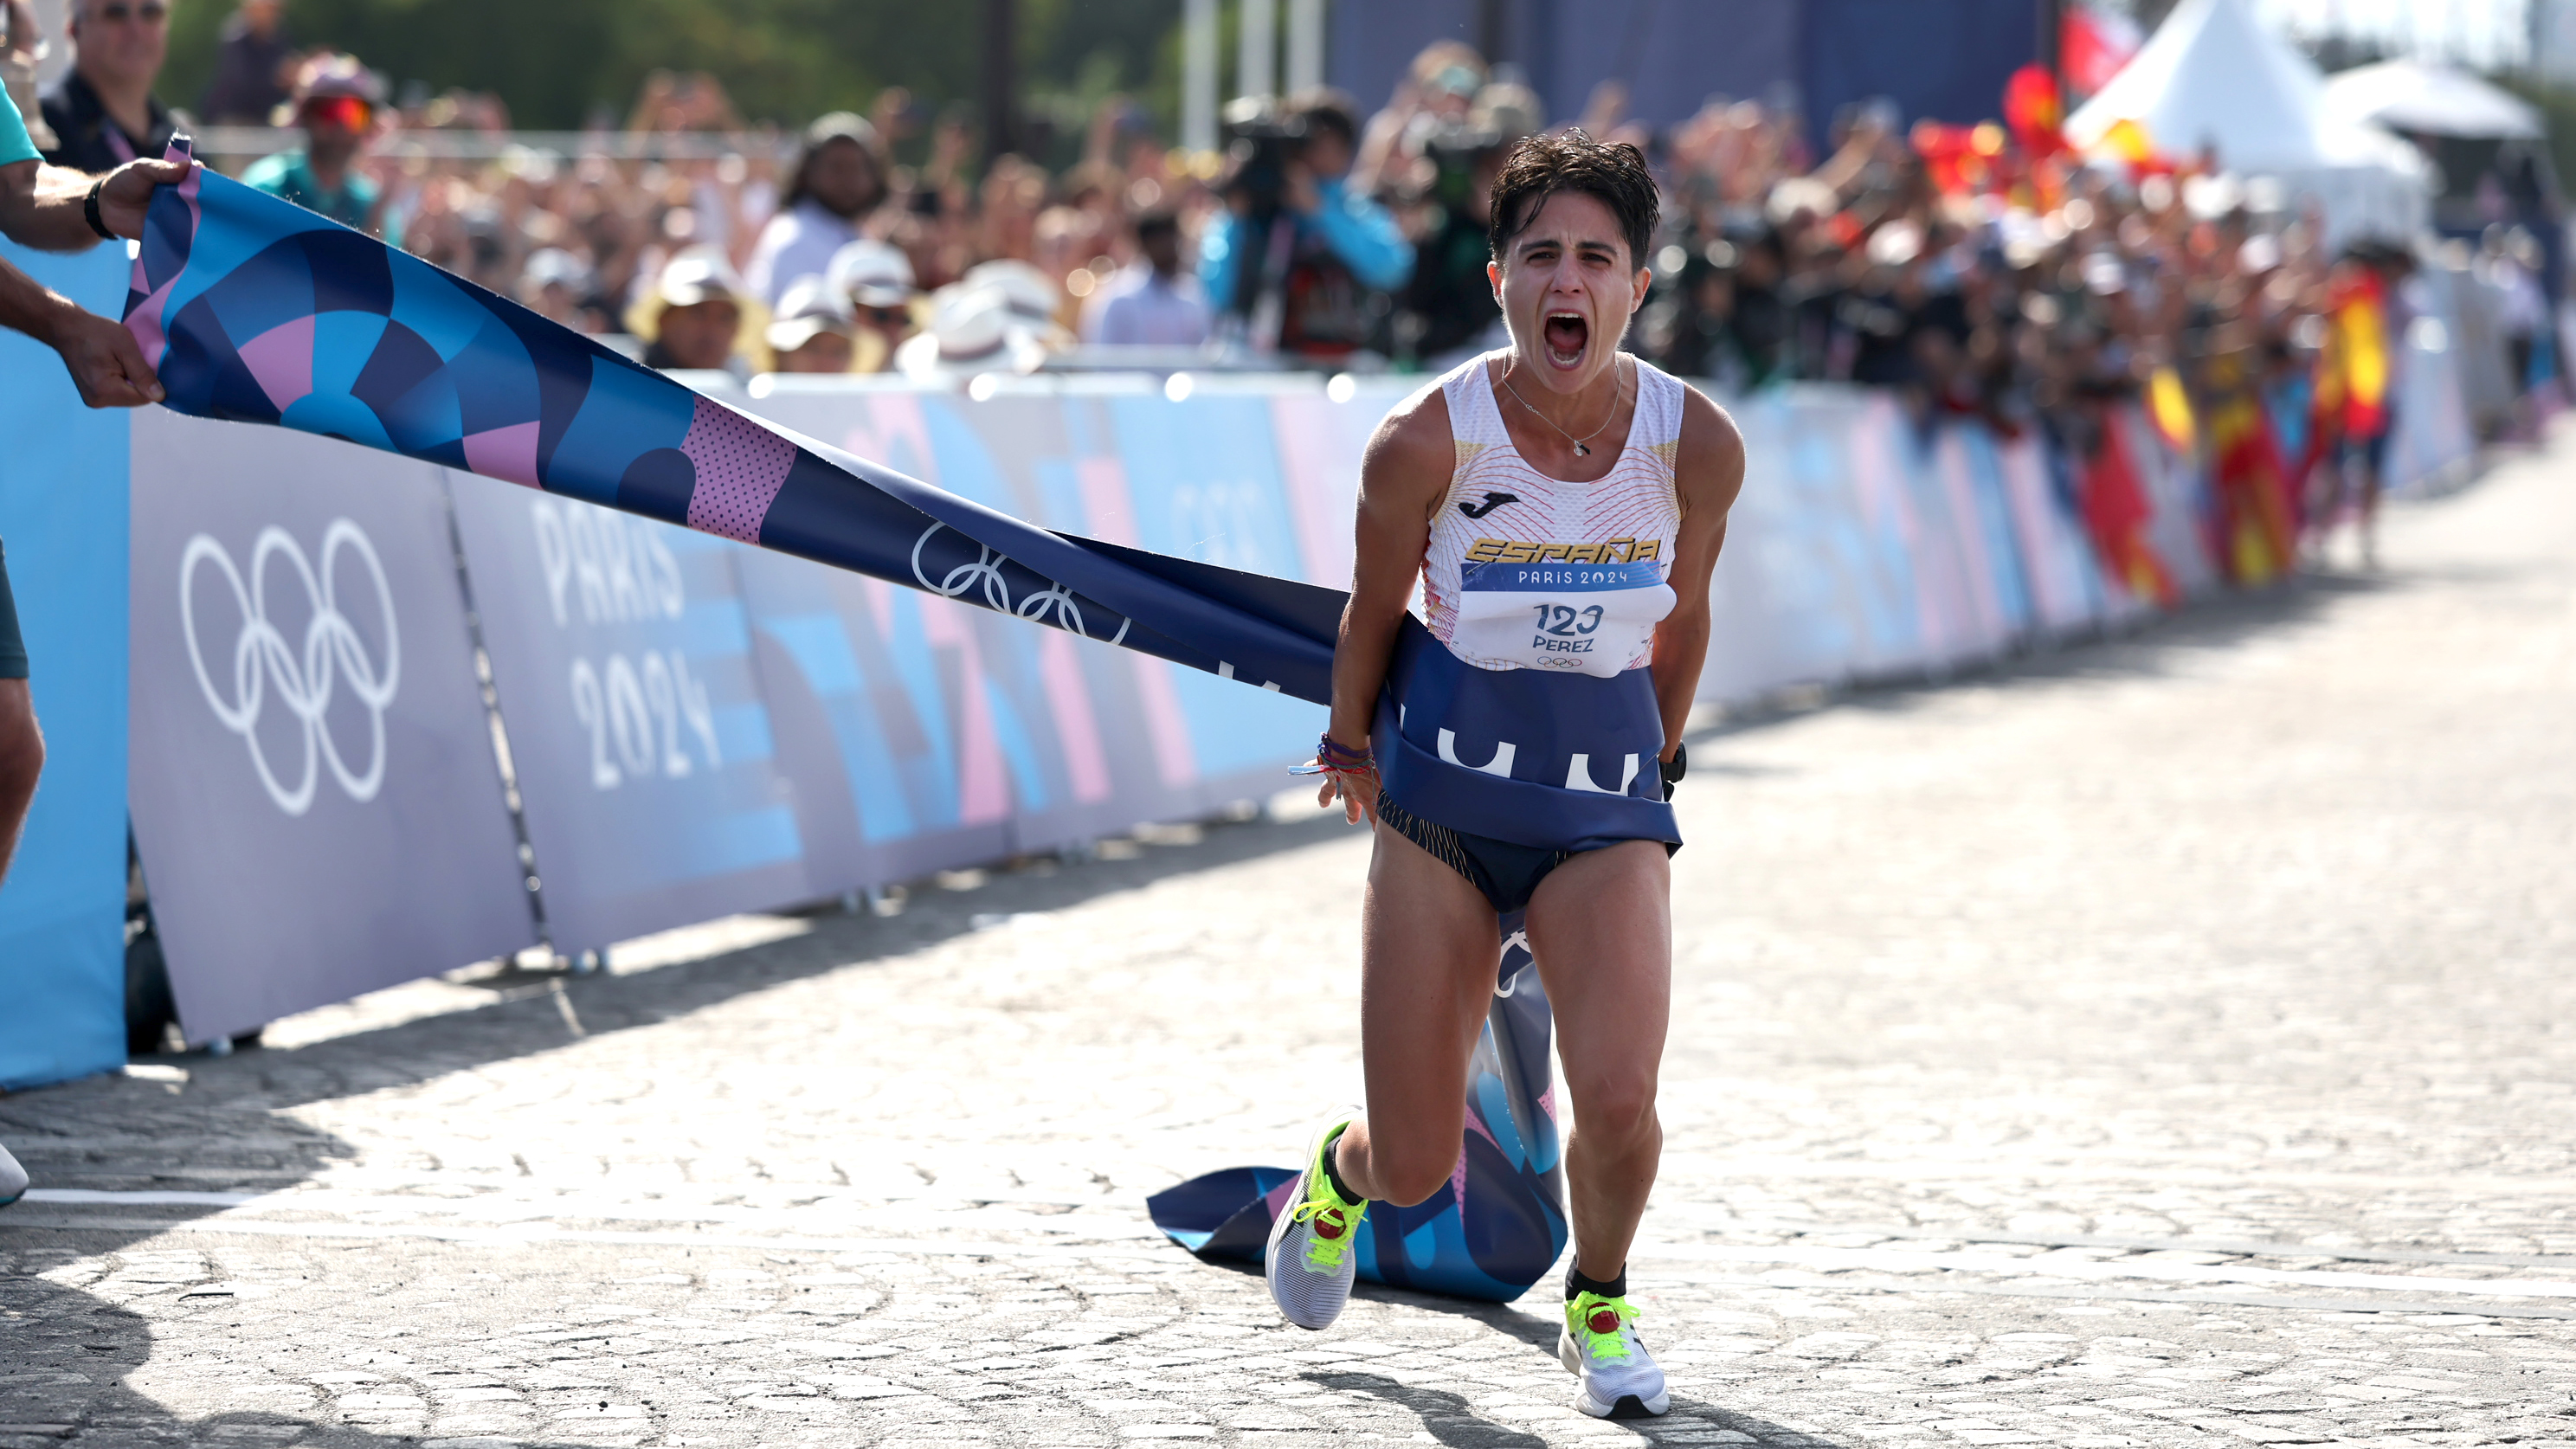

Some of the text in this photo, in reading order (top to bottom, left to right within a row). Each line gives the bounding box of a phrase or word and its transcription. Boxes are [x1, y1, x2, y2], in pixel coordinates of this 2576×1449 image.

[1465, 537, 1661, 564] ESPAÑA
[1581, 571, 1627, 584] 2024
[1533, 604, 1604, 636] 123
[1532, 634, 1594, 654] PEREZ
[571, 649, 722, 789] 2024
